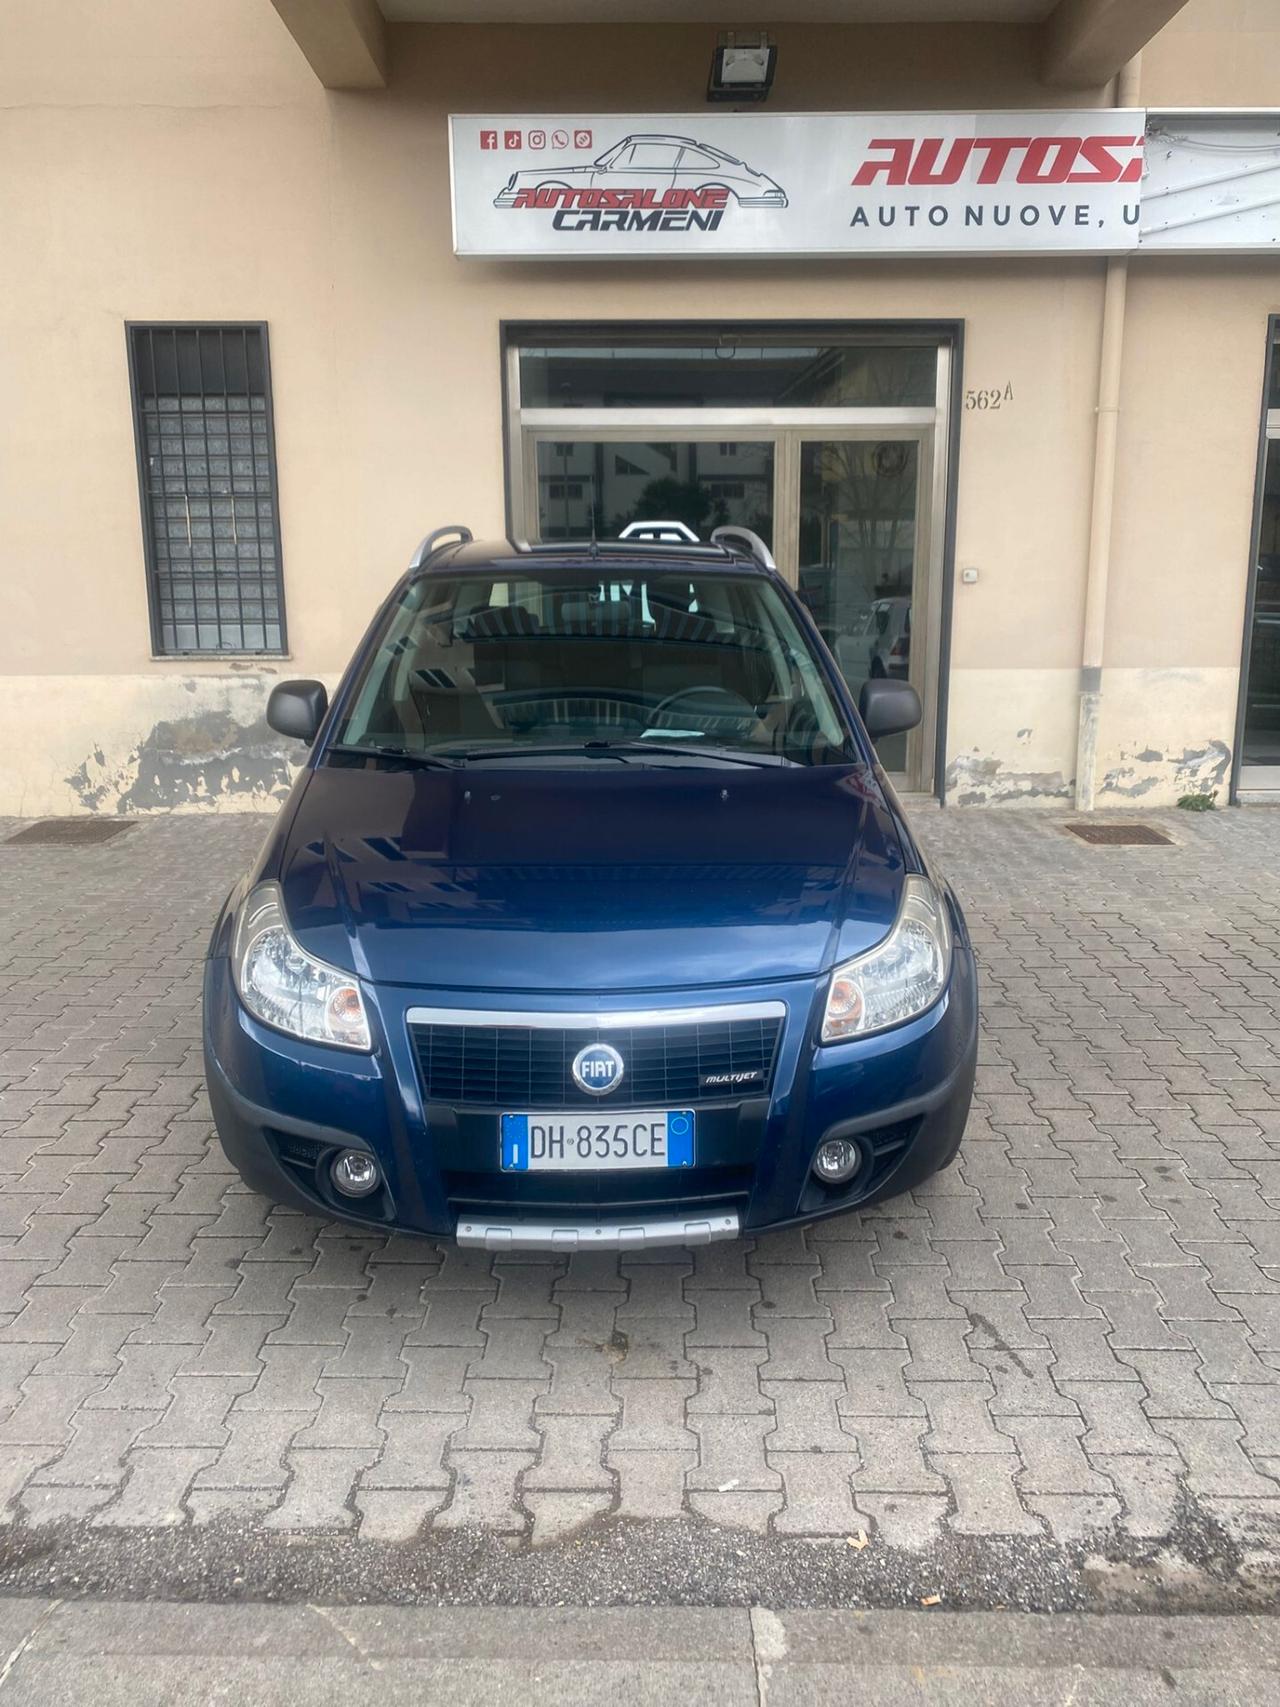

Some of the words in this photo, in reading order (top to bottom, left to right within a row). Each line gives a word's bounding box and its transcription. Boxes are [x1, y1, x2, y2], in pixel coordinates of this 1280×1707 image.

[512, 188, 729, 209] AUTOSALONE
[552, 210, 724, 231] CARMENI
[850, 205, 948, 227] AUTO
[965, 204, 1104, 228] NUOVE,
[581, 1060, 615, 1078] FIAT
[706, 1071, 757, 1084] MULTIJET
